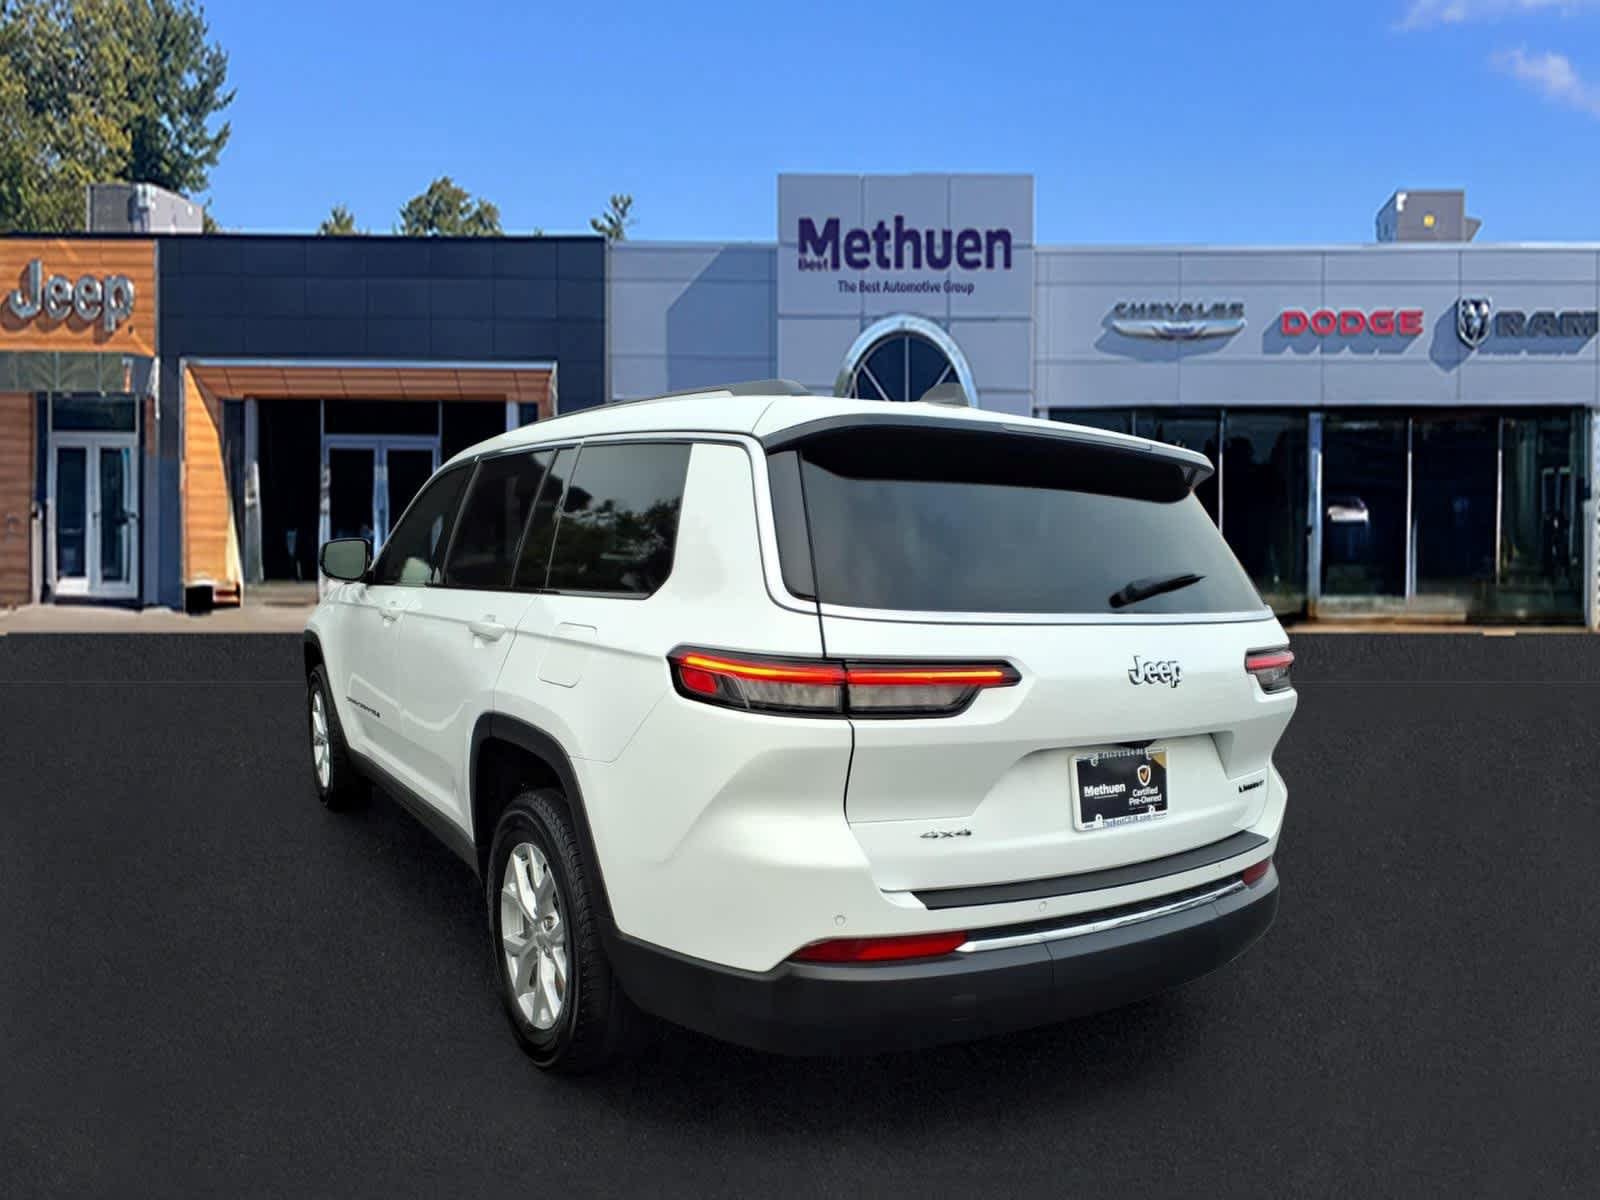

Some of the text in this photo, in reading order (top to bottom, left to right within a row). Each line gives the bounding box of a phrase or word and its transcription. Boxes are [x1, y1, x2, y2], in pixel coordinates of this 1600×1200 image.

[798, 215, 1012, 270] Methuen
[798, 257, 829, 272] Best
[9, 259, 135, 332] Jeep
[838, 279, 975, 295] The Best Automotive Group
[1114, 301, 1245, 319] CHRYSLER
[1281, 309, 1424, 336] DODGE
[1495, 310, 1599, 337] RAM
[1127, 655, 1181, 689] Jeep
[1083, 783, 1126, 798] Methuen
[1128, 793, 1162, 806] Pre-Owned
[1132, 786, 1159, 797] Certified
